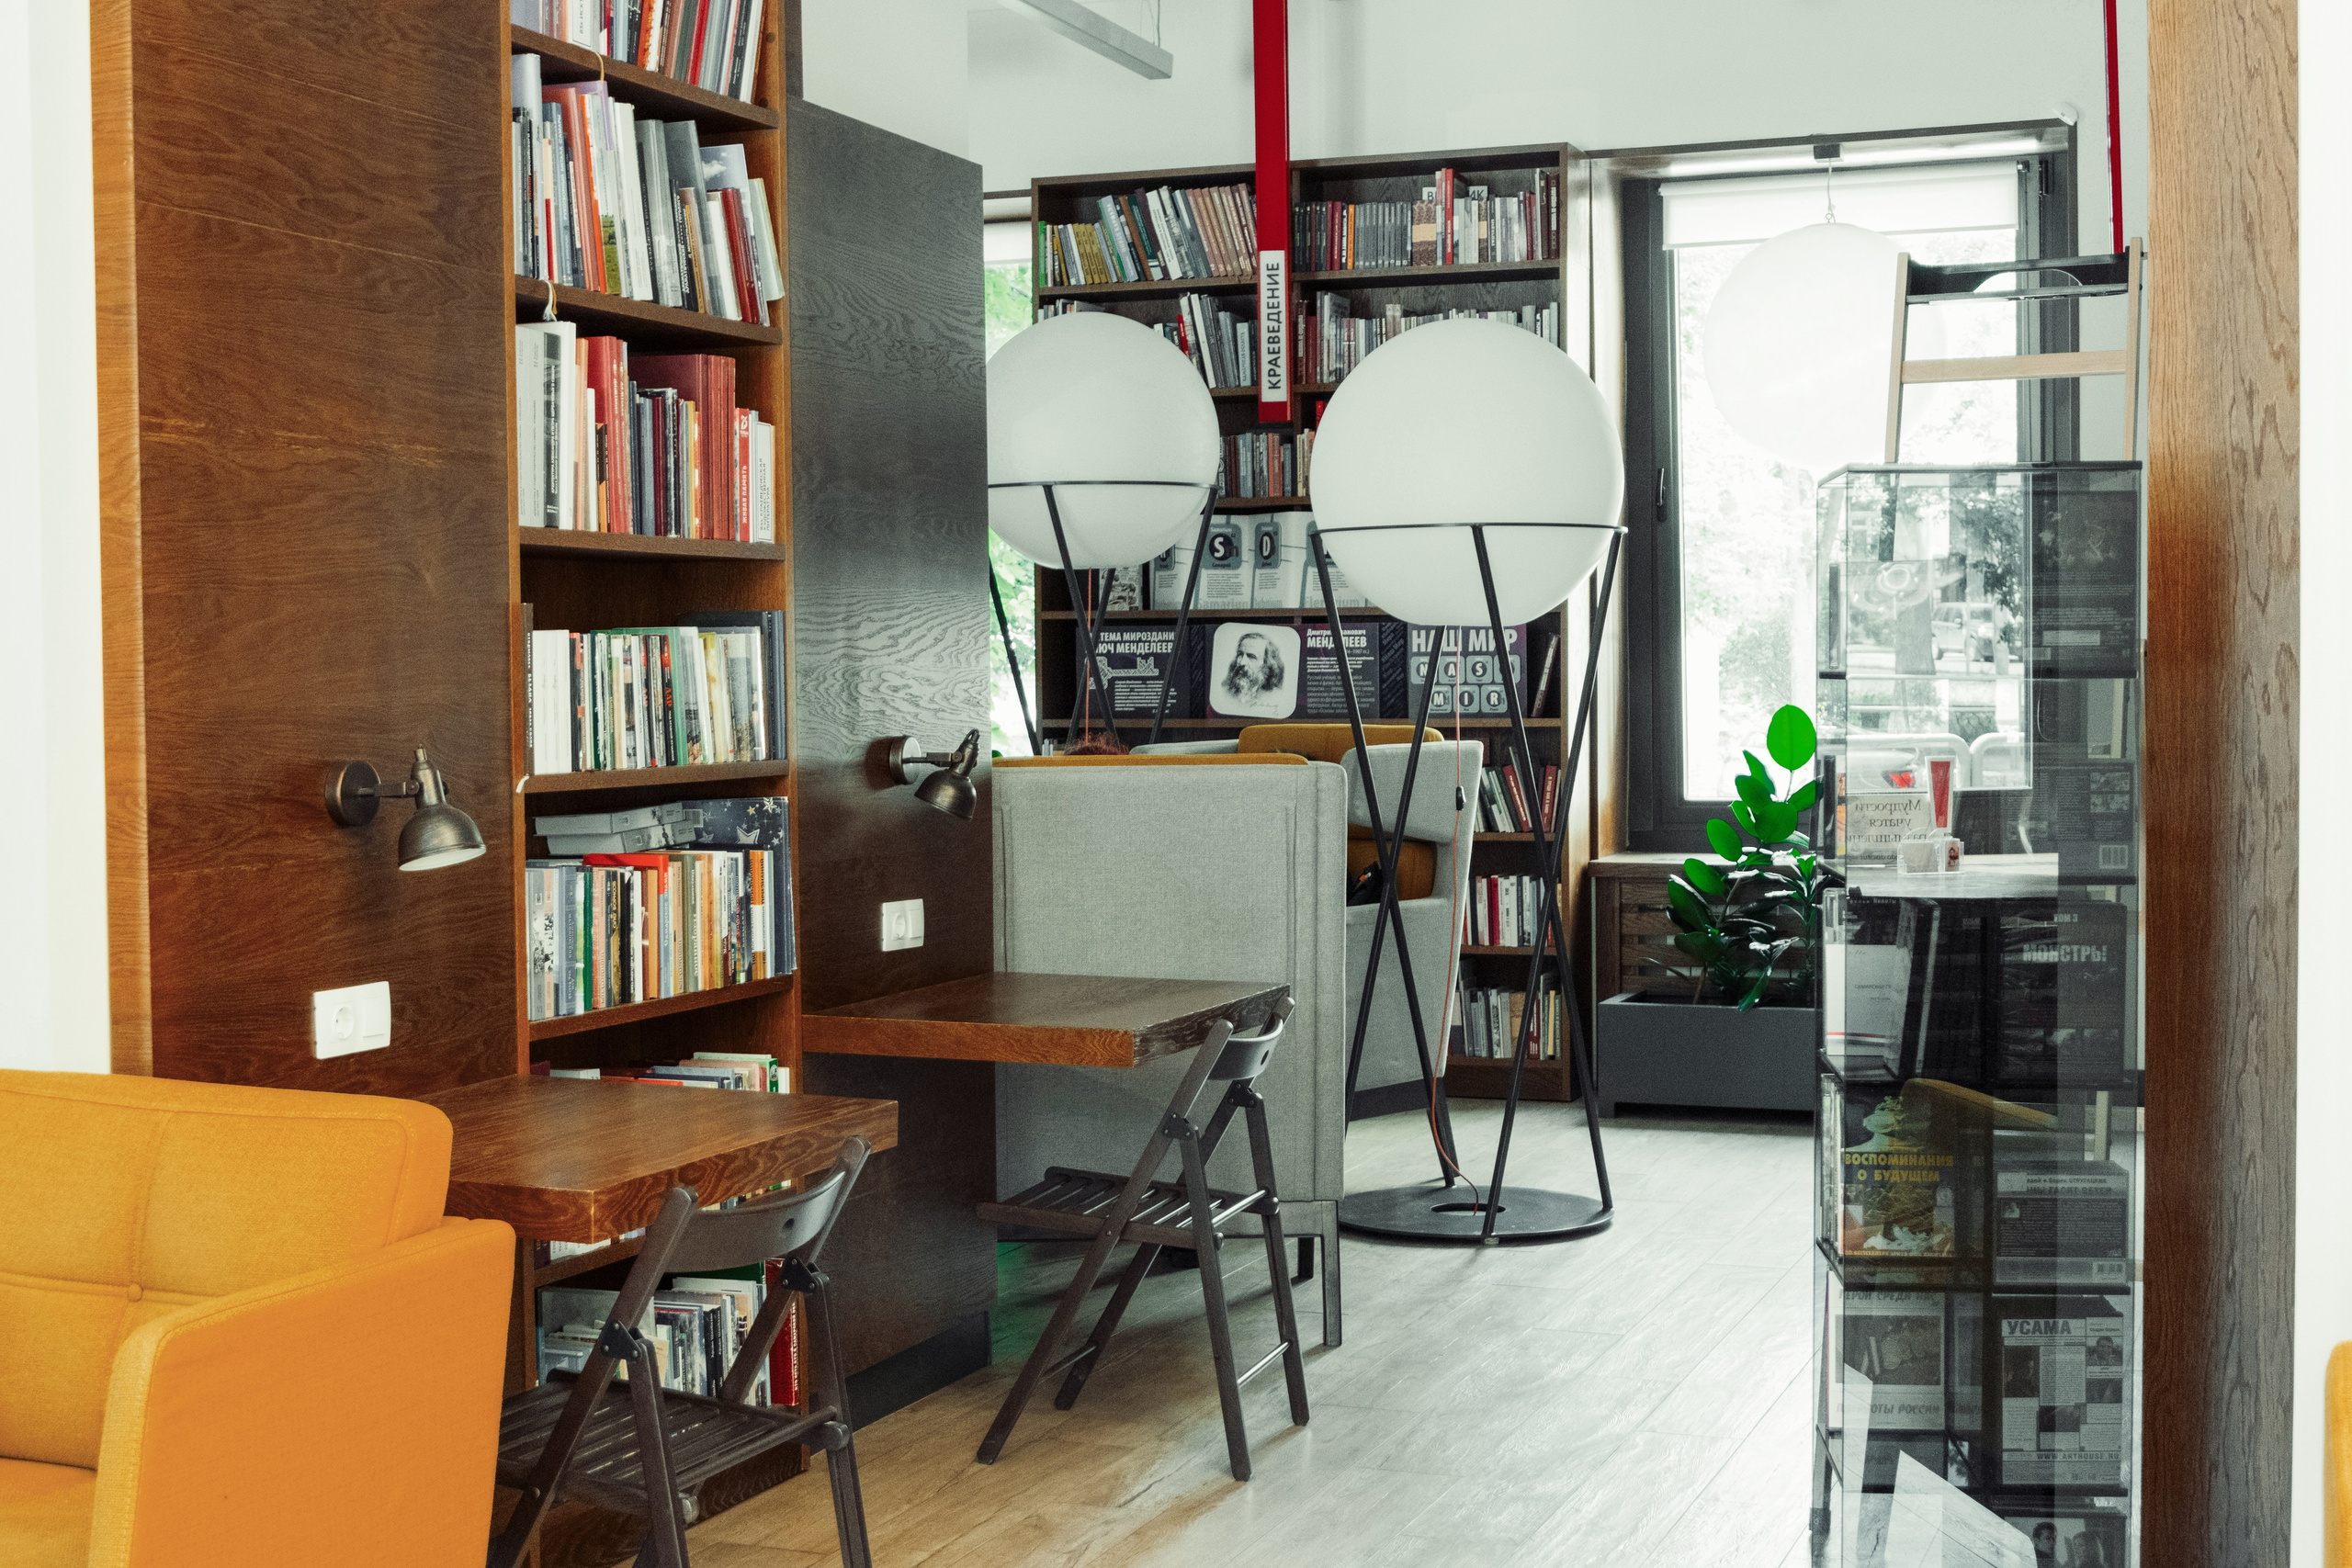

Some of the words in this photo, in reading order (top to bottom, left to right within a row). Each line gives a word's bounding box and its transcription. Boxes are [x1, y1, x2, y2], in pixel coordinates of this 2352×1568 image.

[1266, 263, 1283, 389] КРАЕВЕДЕНИЕ
[1099, 632, 1122, 642] ТЕМА
[1123, 632, 1175, 642] МИРОЗДАНИ
[1306, 628, 1331, 637] Дмитри
[1306, 637, 1367, 649] МЕНДЛЕЕВ
[2072, 913, 2078, 923] 3
[1845, 1154, 1953, 1166] ВОСПОМИНАНИЯ
[1857, 1169, 1868, 1180] О
[1874, 1169, 1940, 1182] БУДУЩЕМ
[2007, 1320, 2072, 1335] УСАМА
